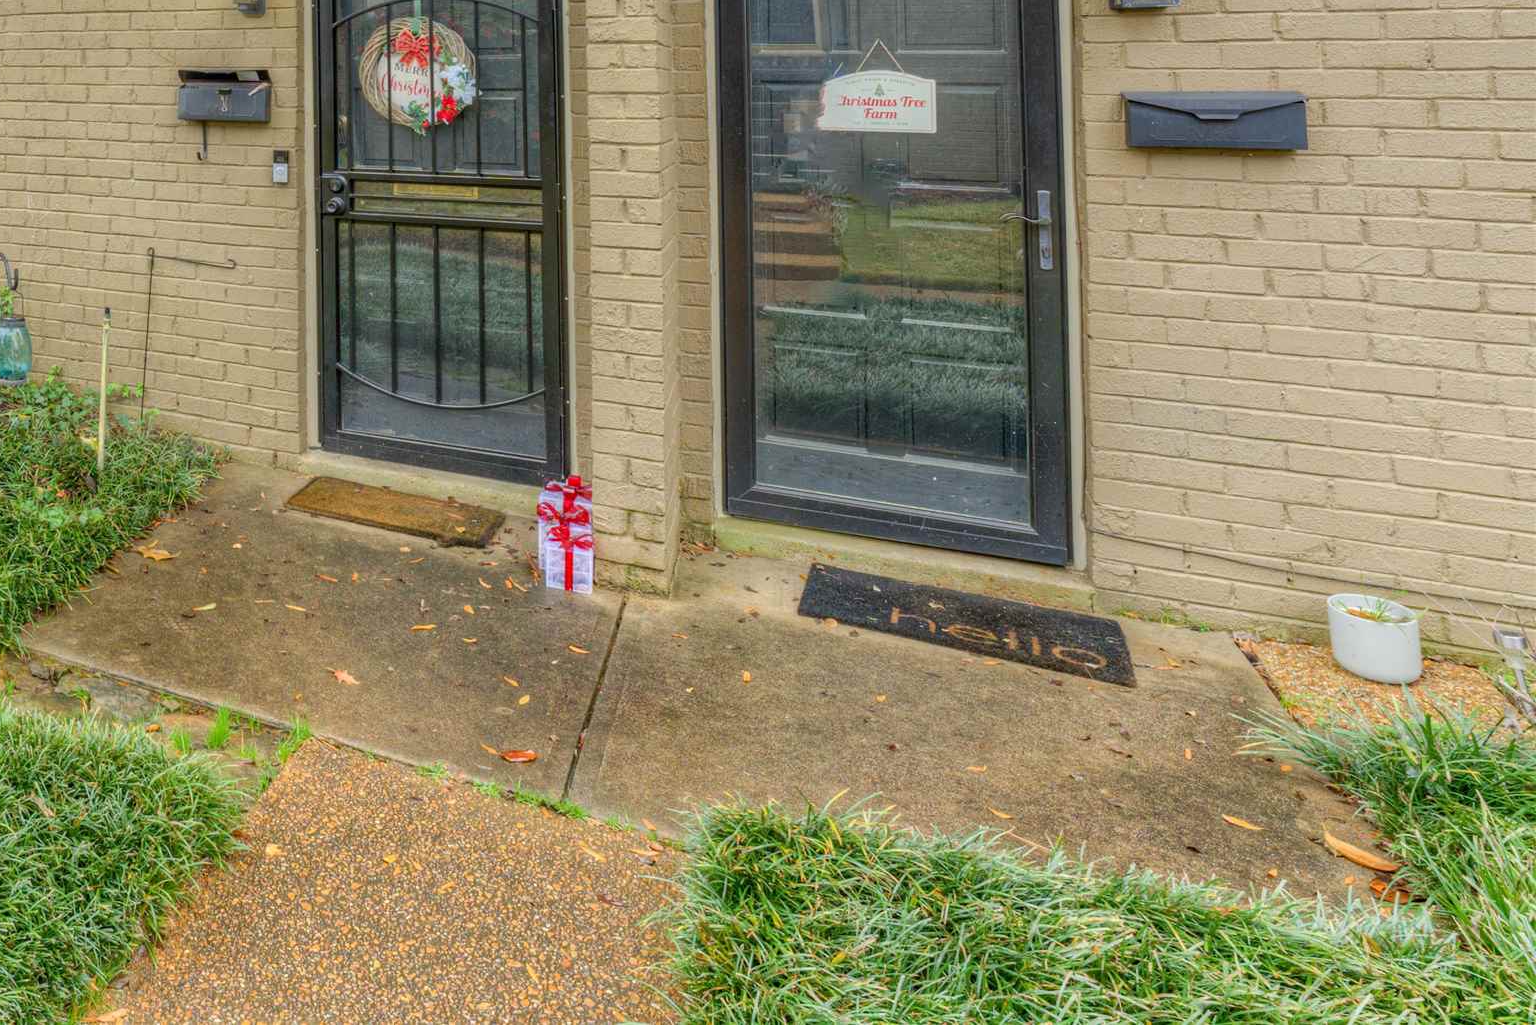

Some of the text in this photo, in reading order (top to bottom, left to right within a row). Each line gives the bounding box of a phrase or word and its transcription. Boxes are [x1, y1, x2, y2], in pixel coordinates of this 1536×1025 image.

[380, 72, 442, 98] Christm
[900, 95, 927, 109] Tree
[864, 108, 897, 120] Farm
